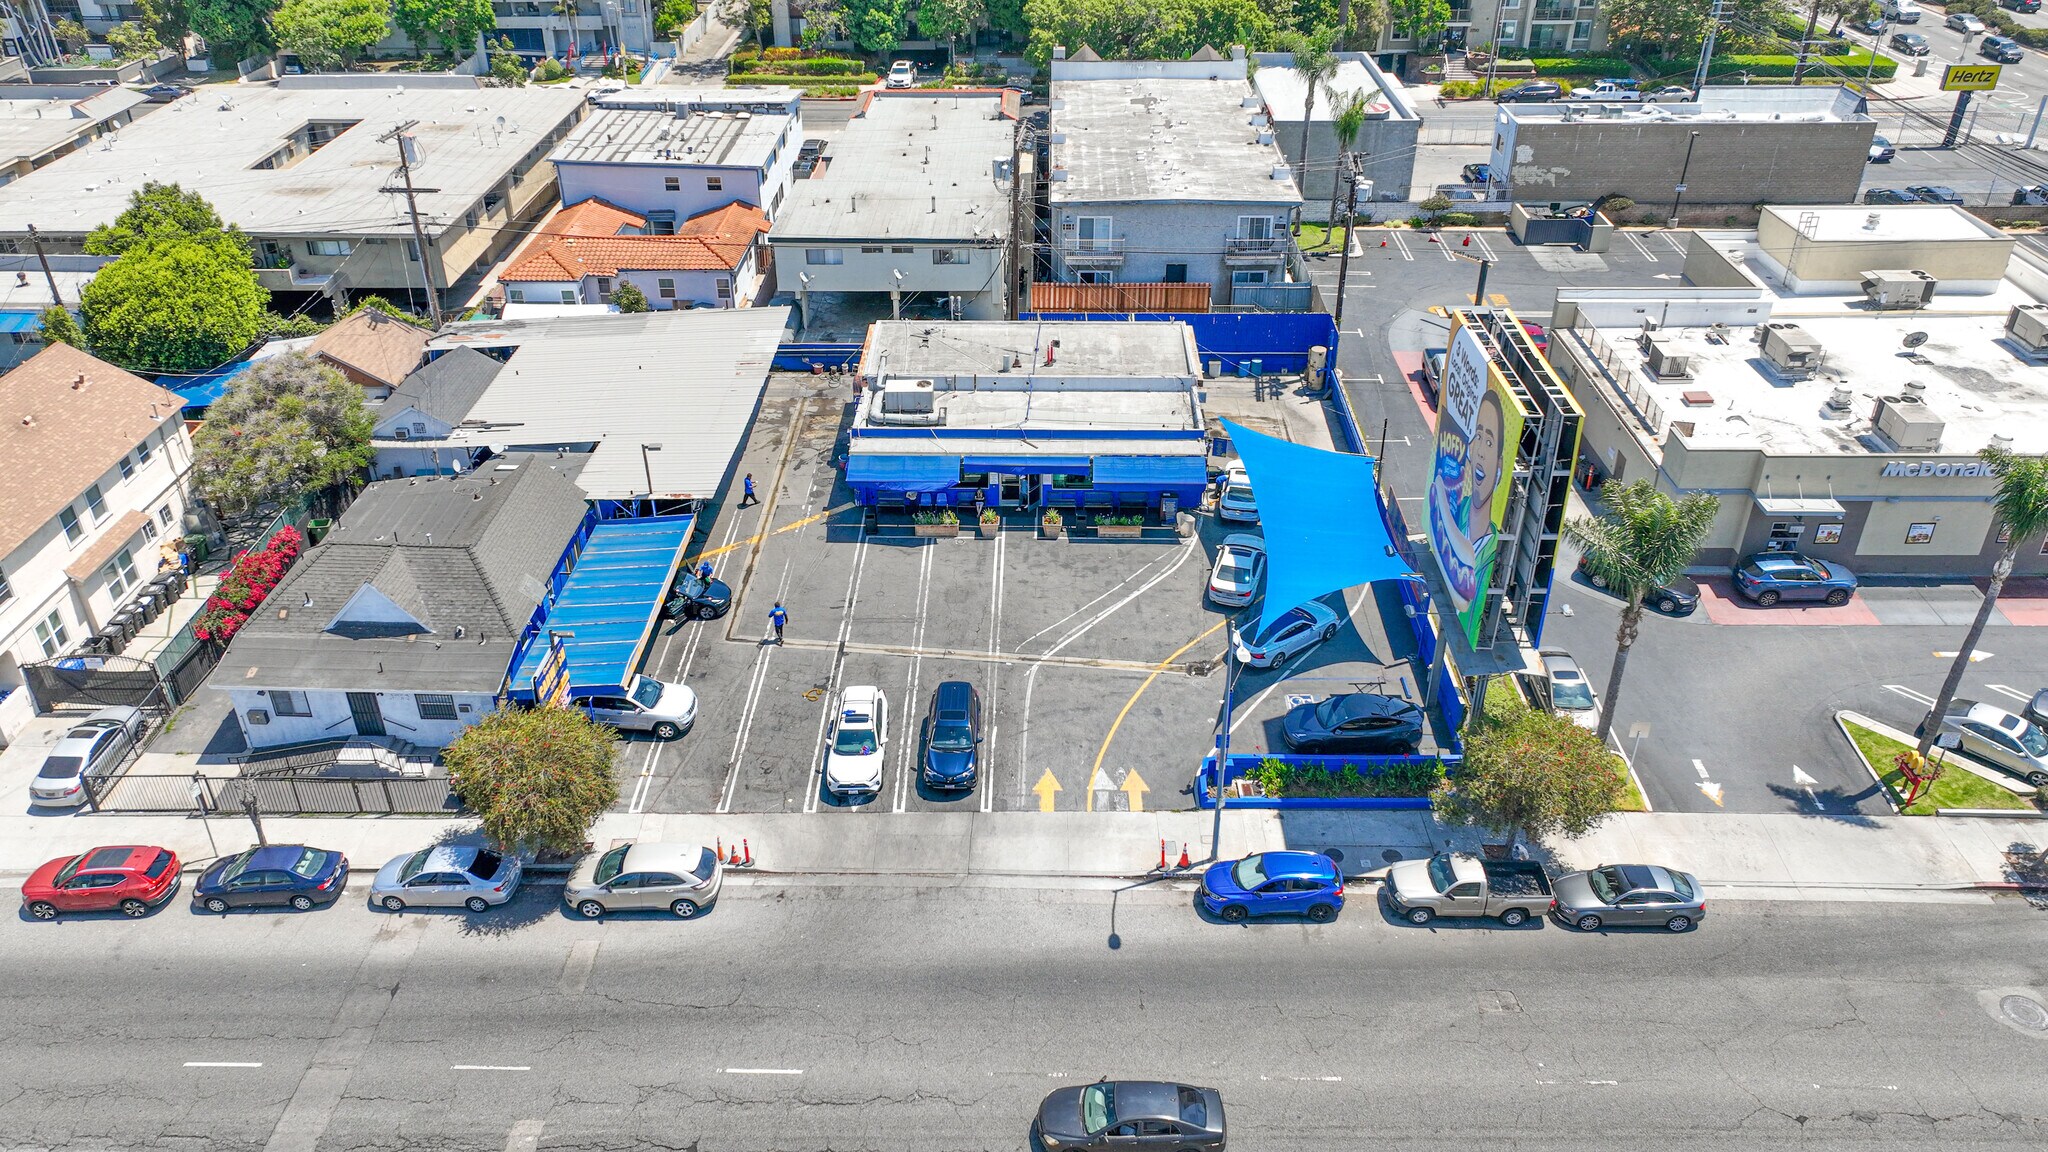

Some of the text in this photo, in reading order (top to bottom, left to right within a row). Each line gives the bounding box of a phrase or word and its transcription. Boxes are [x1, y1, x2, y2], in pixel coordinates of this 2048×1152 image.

[1951, 70, 1995, 82] Hertz
[1456, 341, 1462, 357] 3
[1448, 372, 1475, 435] GREAT.
[1440, 431, 1466, 462] HOFFY
